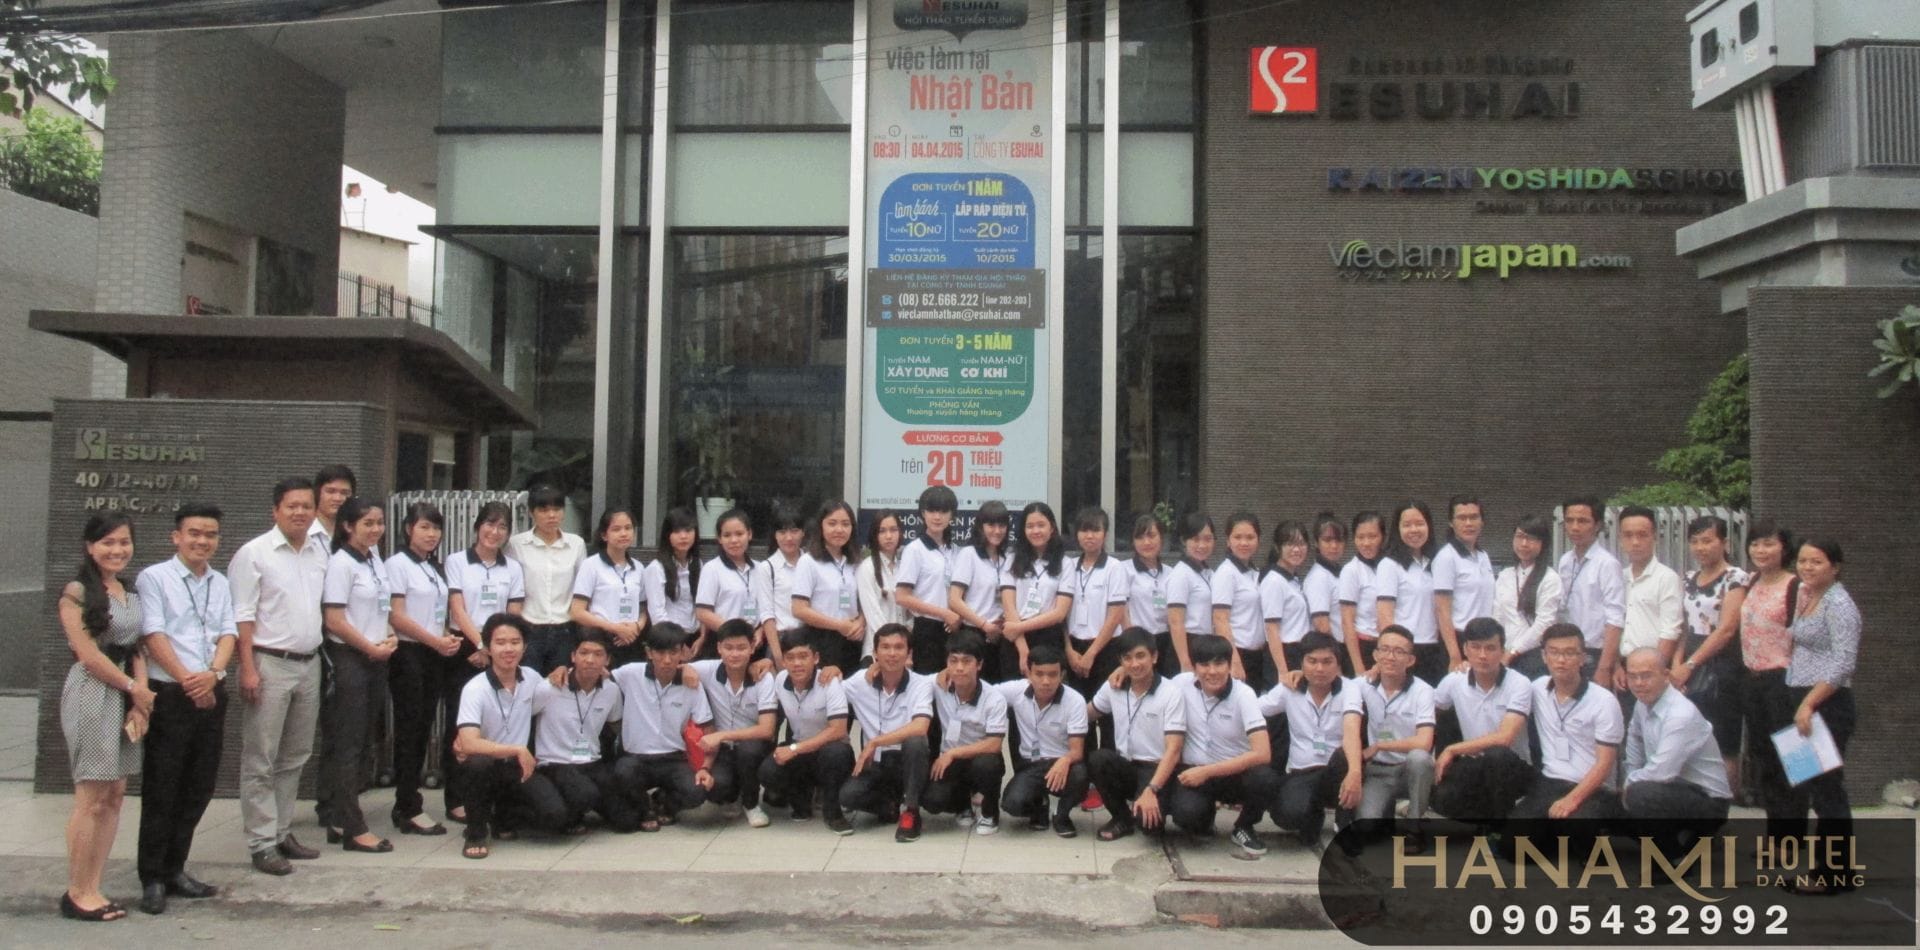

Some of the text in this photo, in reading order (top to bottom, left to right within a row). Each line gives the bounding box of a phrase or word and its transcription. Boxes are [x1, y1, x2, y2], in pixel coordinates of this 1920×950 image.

[887, 46, 990, 74] việc làm tại
[910, 70, 1033, 118] Nhật Bản
[1328, 81, 1581, 120] ESUHAI
[873, 142, 900, 158] 08:30
[912, 142, 963, 158] 04.04.2015
[1010, 142, 1043, 158] ESUHAI
[1475, 167, 1635, 190] YOSHIDA
[975, 178, 1003, 196] NĂM
[906, 222, 926, 238] 10
[977, 222, 1002, 238] 20
[888, 254, 946, 263] 30/03/2015
[976, 254, 1015, 263] 10/2015
[898, 293, 919, 307] (08)
[922, 293, 979, 307] 62.666.222
[956, 334, 964, 350] 3
[974, 334, 982, 350] 5
[984, 332, 1012, 350] NĂM
[907, 355, 931, 364] NAM
[887, 365, 914, 378] XÂY
[960, 365, 1008, 378] CƠ KHÍ
[107, 444, 205, 461] ESUHAI
[901, 449, 1002, 486] trên 20 TRIỆU
[970, 473, 1002, 489] tháng
